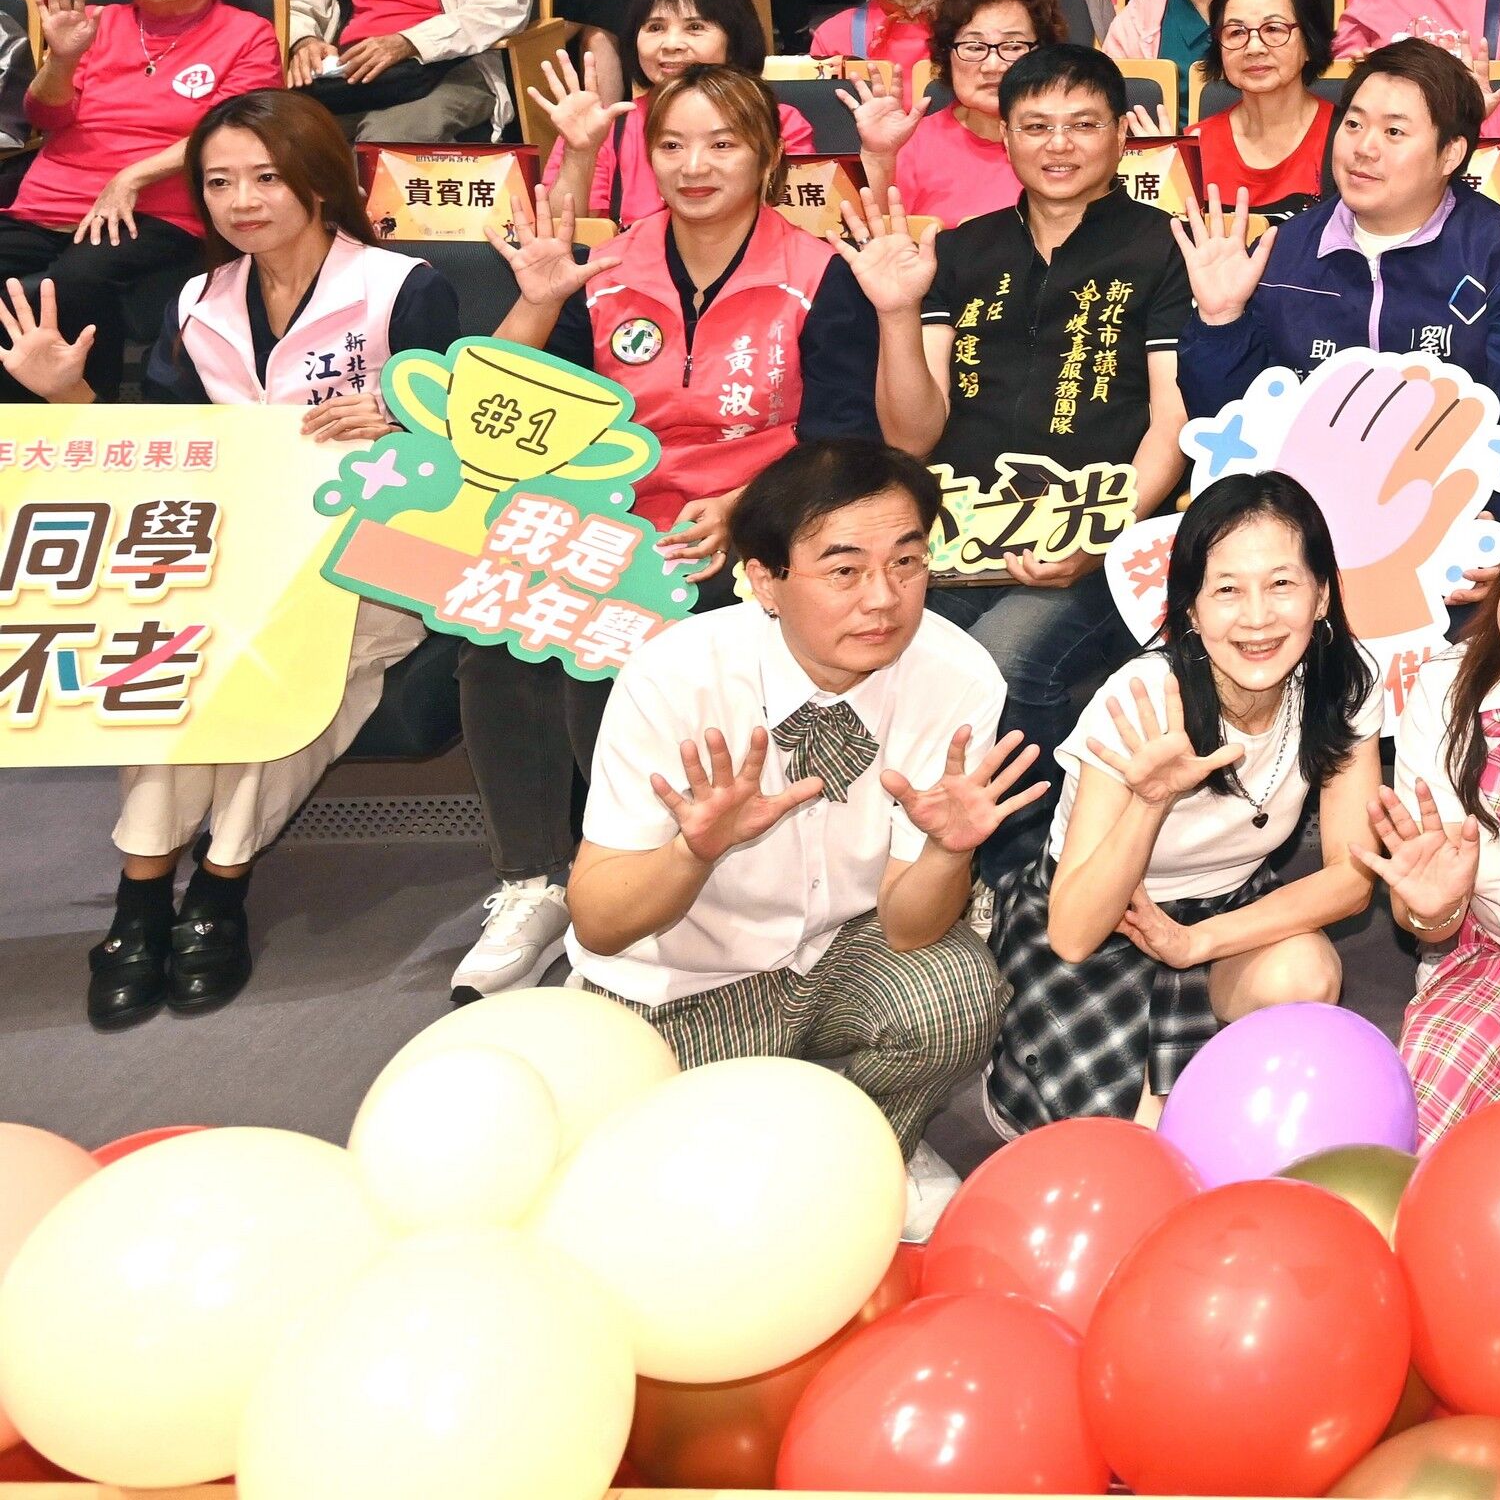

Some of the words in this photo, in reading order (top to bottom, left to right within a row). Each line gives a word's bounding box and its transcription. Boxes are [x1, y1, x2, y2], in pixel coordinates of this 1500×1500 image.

[404, 178, 496, 207] 貴賓席
[344, 332, 367, 393] 新北市
[955, 297, 985, 398] 盧建智
[1089, 278, 1134, 403] 新北市議員
[471, 393, 557, 455] #1
[0, 500, 212, 590] 同學
[487, 494, 638, 588] 我是
[0, 620, 206, 715] 不老
